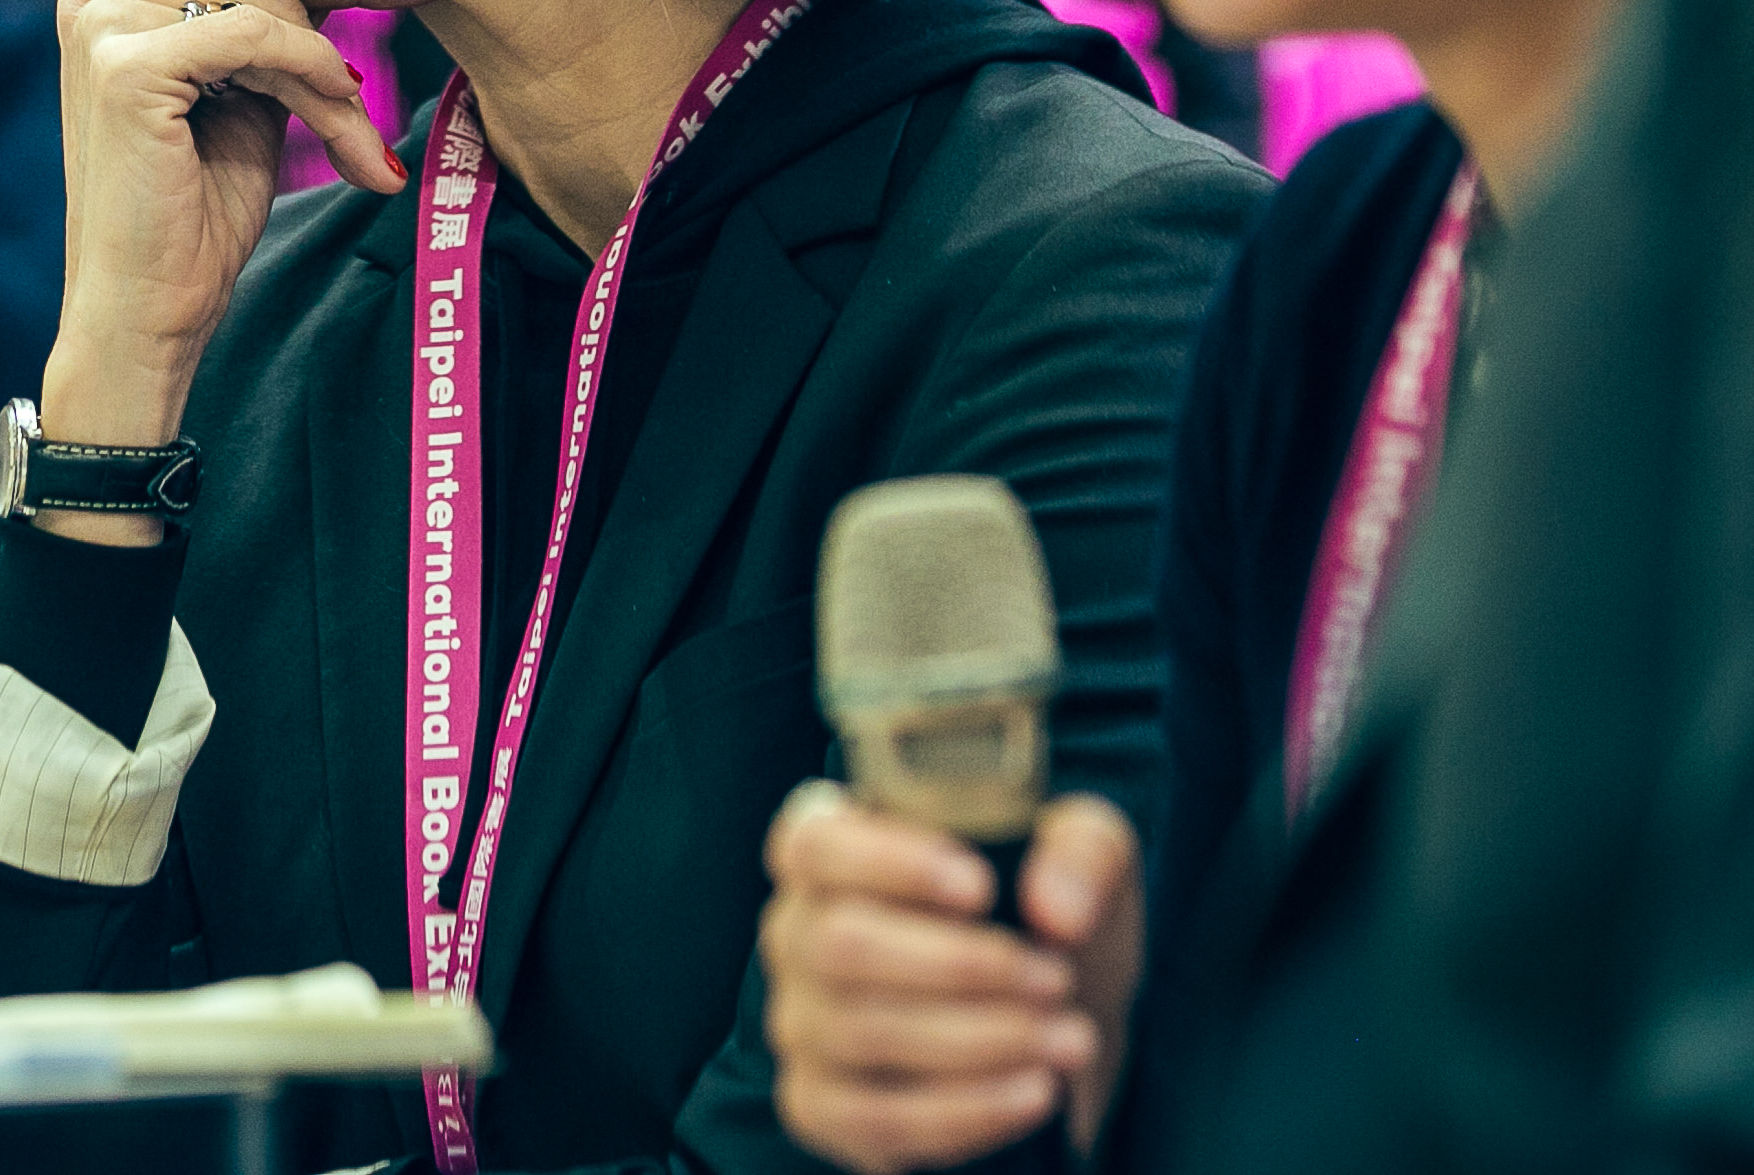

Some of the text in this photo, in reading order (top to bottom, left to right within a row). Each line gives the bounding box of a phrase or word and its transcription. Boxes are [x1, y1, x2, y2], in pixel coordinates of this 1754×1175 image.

[420, 267, 464, 419] Taipei
[422, 431, 463, 761] International
[506, 573, 552, 728] Taipei
[549, 224, 628, 559] International
[422, 775, 460, 904] Book
